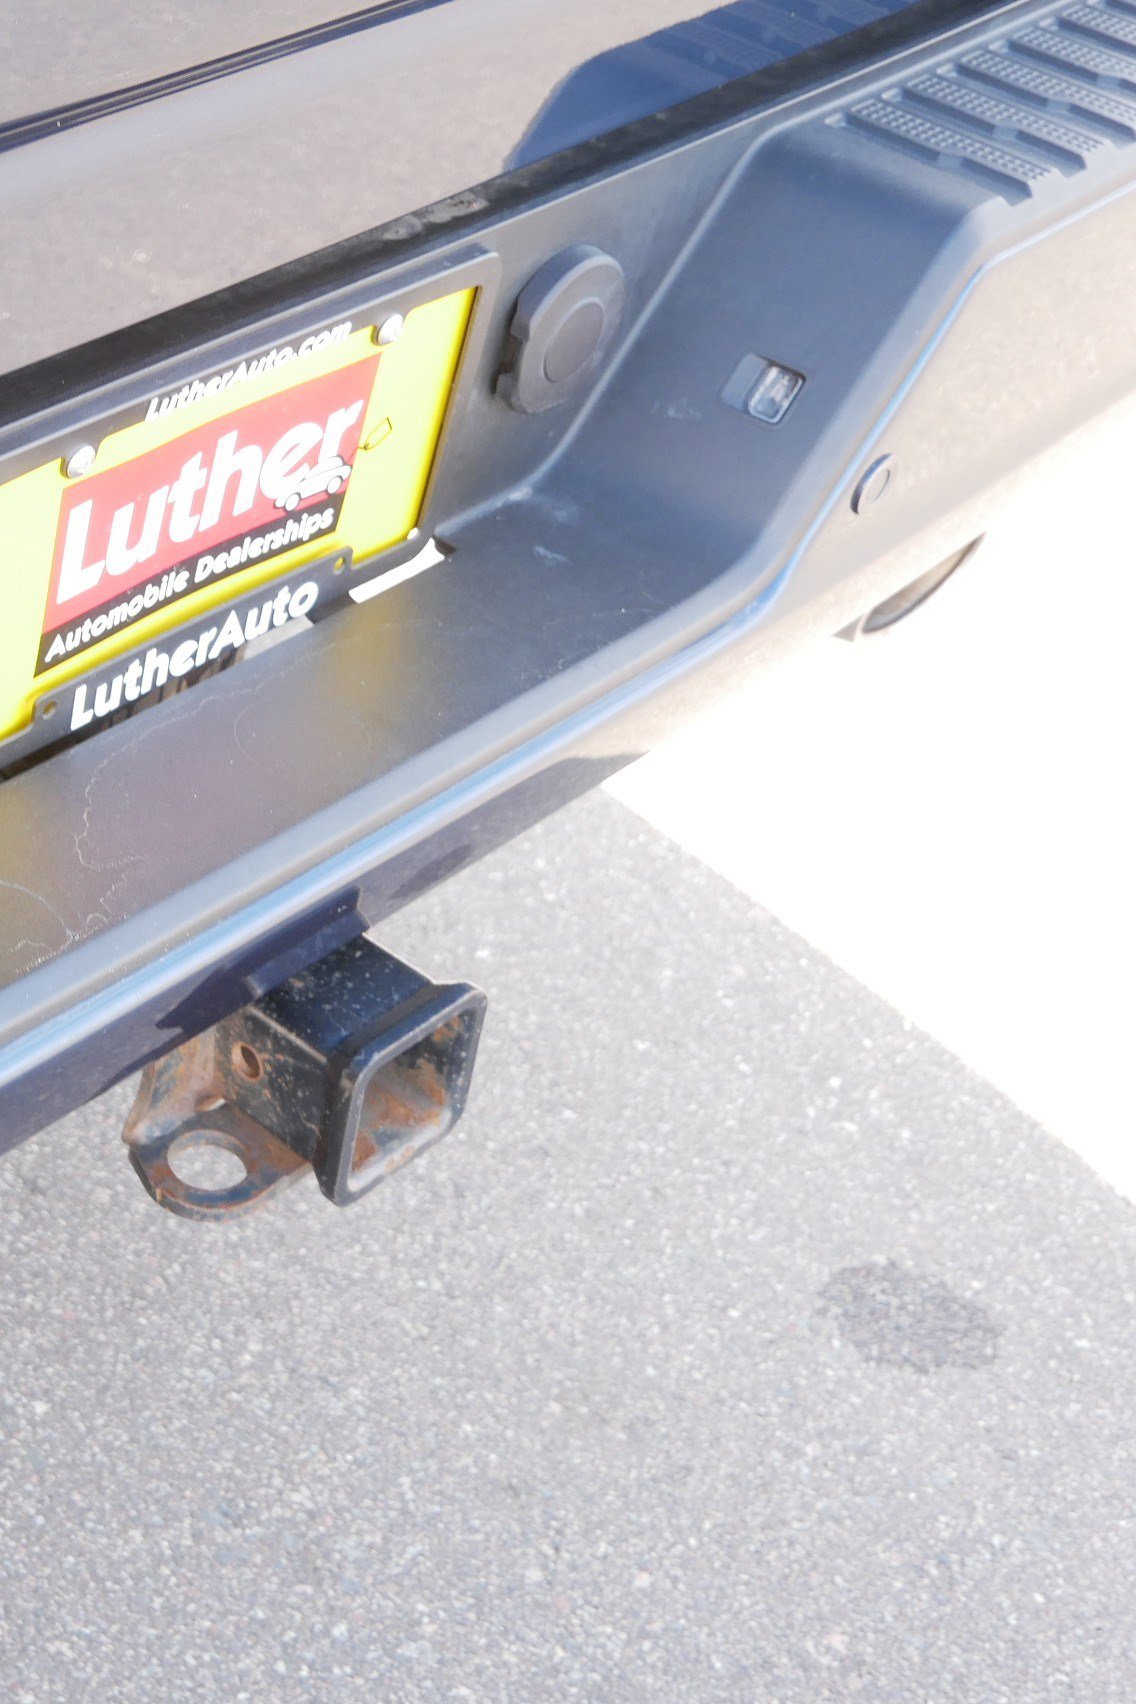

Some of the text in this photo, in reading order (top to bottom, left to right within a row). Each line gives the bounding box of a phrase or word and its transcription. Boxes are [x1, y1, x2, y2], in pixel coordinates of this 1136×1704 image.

[145, 321, 352, 422] LutherAuto.com
[56, 400, 363, 604] Luther
[44, 507, 334, 663] Automobile Dealerships
[70, 581, 318, 731] LutherAuto
